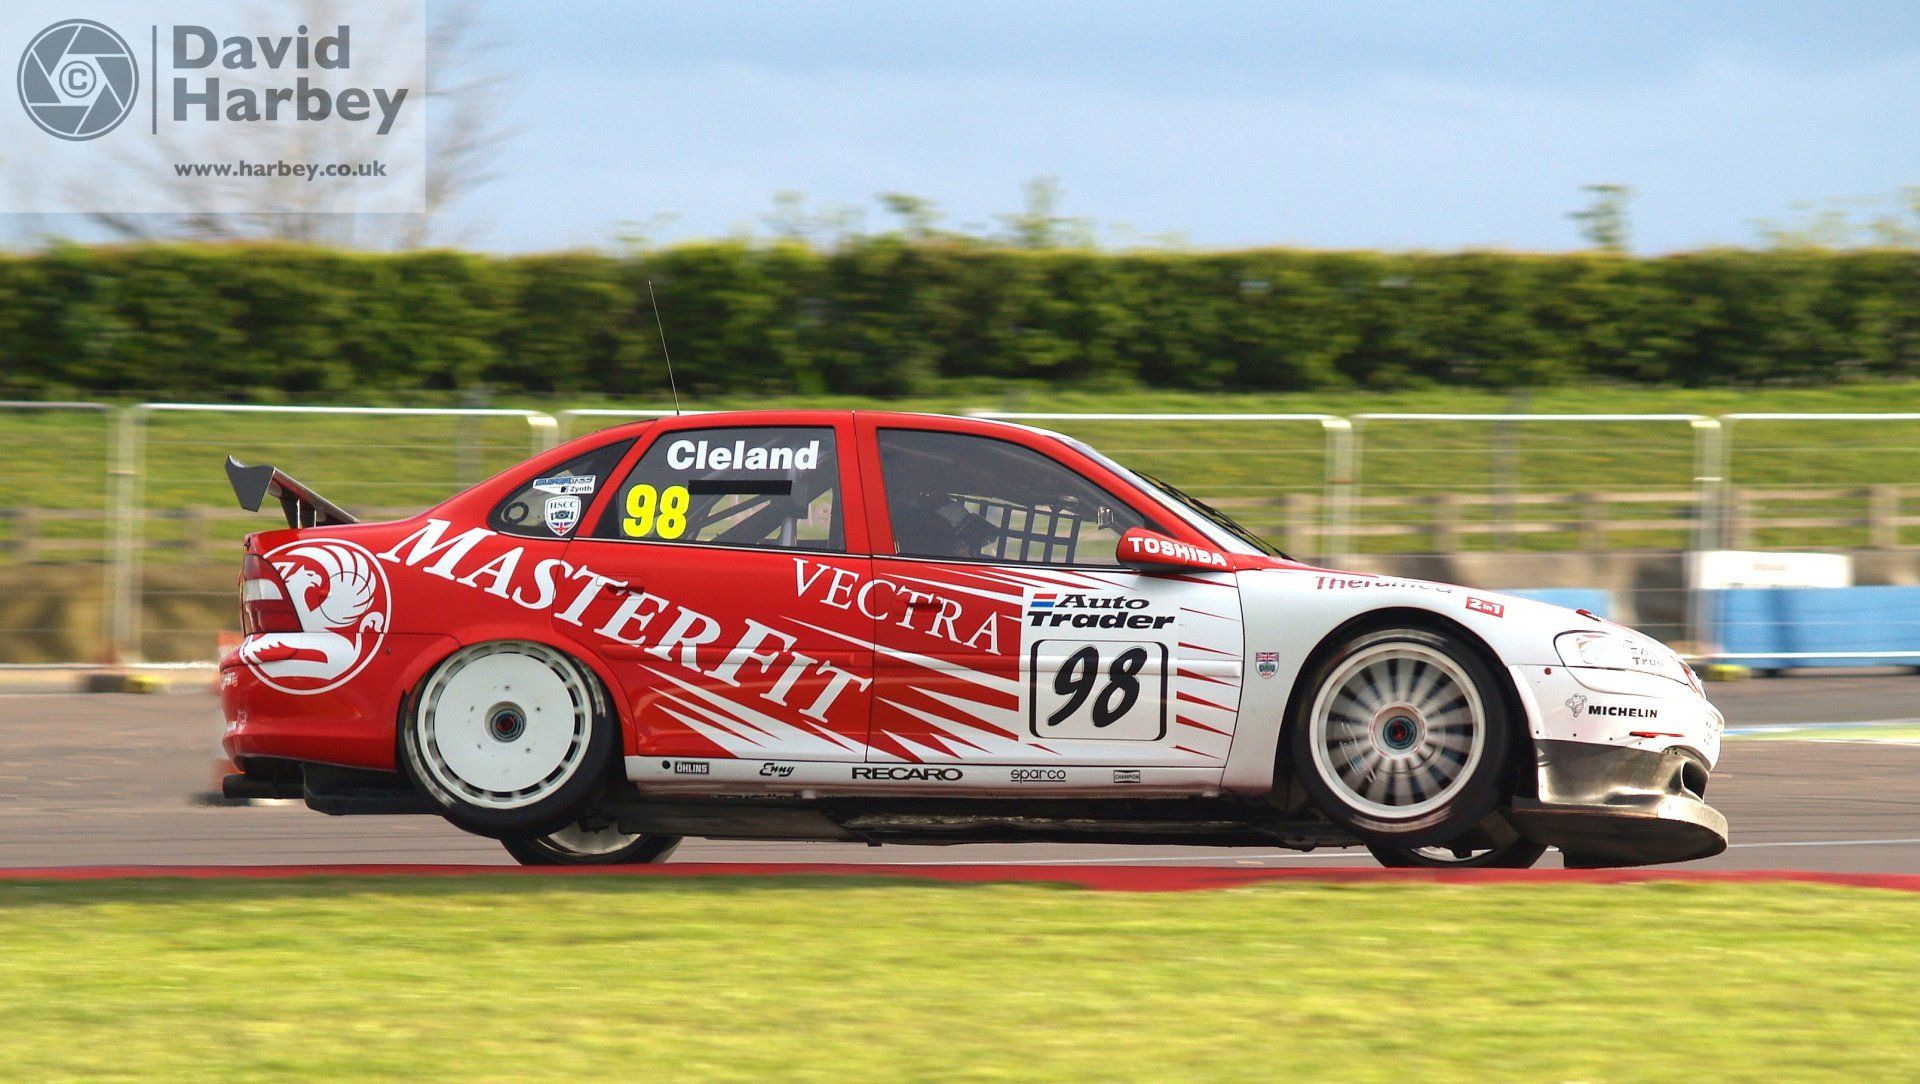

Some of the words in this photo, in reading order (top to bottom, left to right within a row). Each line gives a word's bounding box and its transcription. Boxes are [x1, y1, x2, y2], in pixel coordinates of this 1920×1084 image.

[666, 439, 819, 470] Cleland
[622, 484, 690, 539] 98
[1128, 537, 1227, 566] TOSHIBA
[1315, 576, 1452, 594] Ther
[793, 557, 1001, 655] VECTRA
[1054, 594, 1150, 609] Auto
[376, 518, 873, 723] MASTERFIT
[1027, 611, 1175, 630] Trader
[1046, 645, 1148, 728] 98
[1588, 705, 1658, 718] MICHELIN
[852, 767, 963, 781] RECARO
[1011, 769, 1066, 783] sparco
